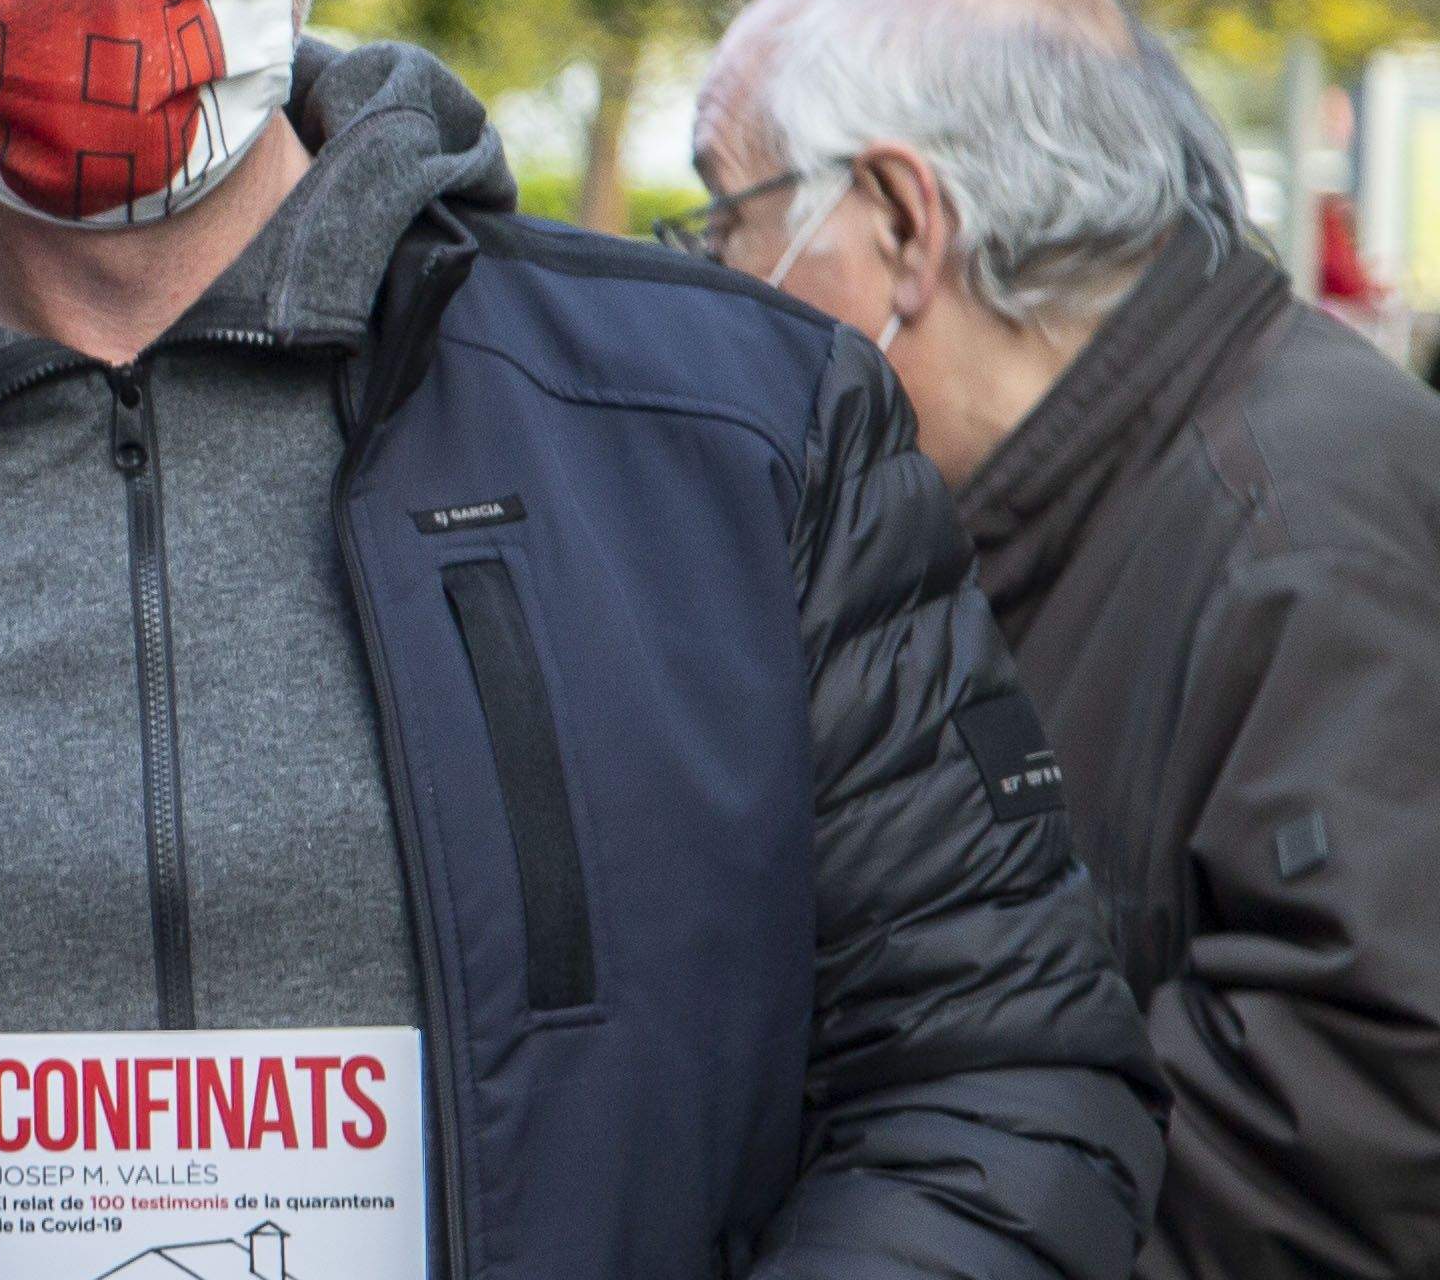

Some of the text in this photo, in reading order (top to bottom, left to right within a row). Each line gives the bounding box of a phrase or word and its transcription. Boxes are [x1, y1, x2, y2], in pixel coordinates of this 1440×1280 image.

[83, 1165, 110, 1187] M.
[117, 1159, 219, 1186] VALLÈS
[12, 1195, 54, 1211] relat
[60, 1195, 84, 1211] de
[90, 1195, 125, 1211] 100
[131, 1194, 229, 1211] testimonis
[234, 1194, 258, 1210] de
[264, 1194, 280, 1210] la
[285, 1195, 395, 1215] quarantena
[19, 1217, 36, 1233] la
[41, 1217, 123, 1233] Covid-19
